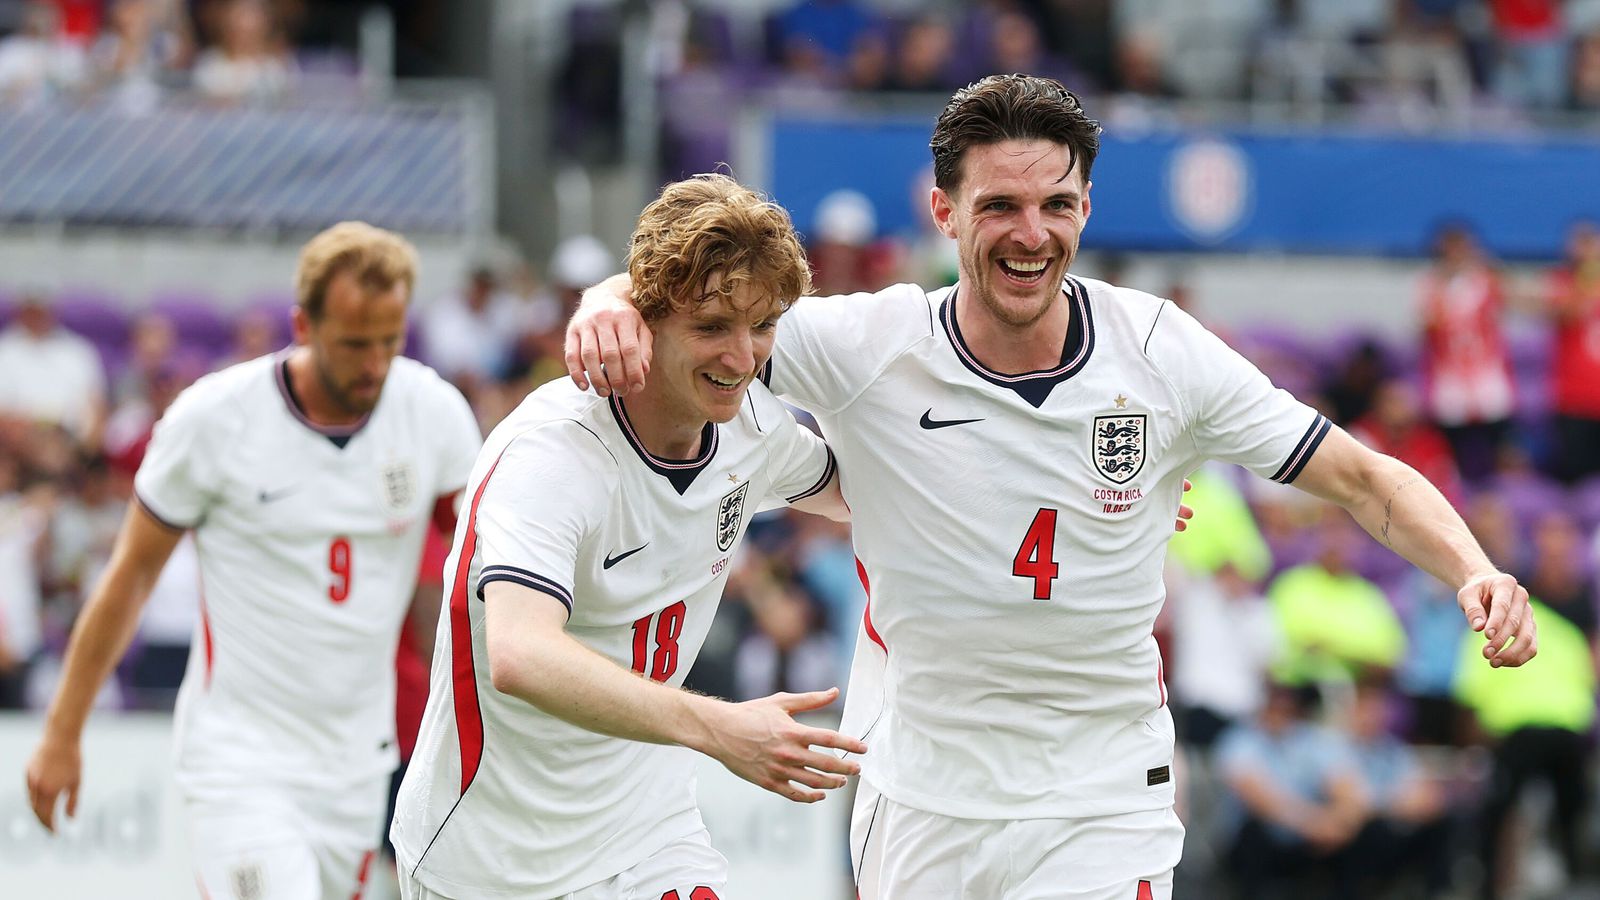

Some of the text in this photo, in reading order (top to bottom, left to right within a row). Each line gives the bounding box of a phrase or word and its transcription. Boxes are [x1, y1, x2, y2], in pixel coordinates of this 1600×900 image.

[1094, 488, 1143, 501] COSTA RICA
[329, 537, 352, 604] 9
[1013, 508, 1059, 600] 4
[632, 600, 687, 683] 18
